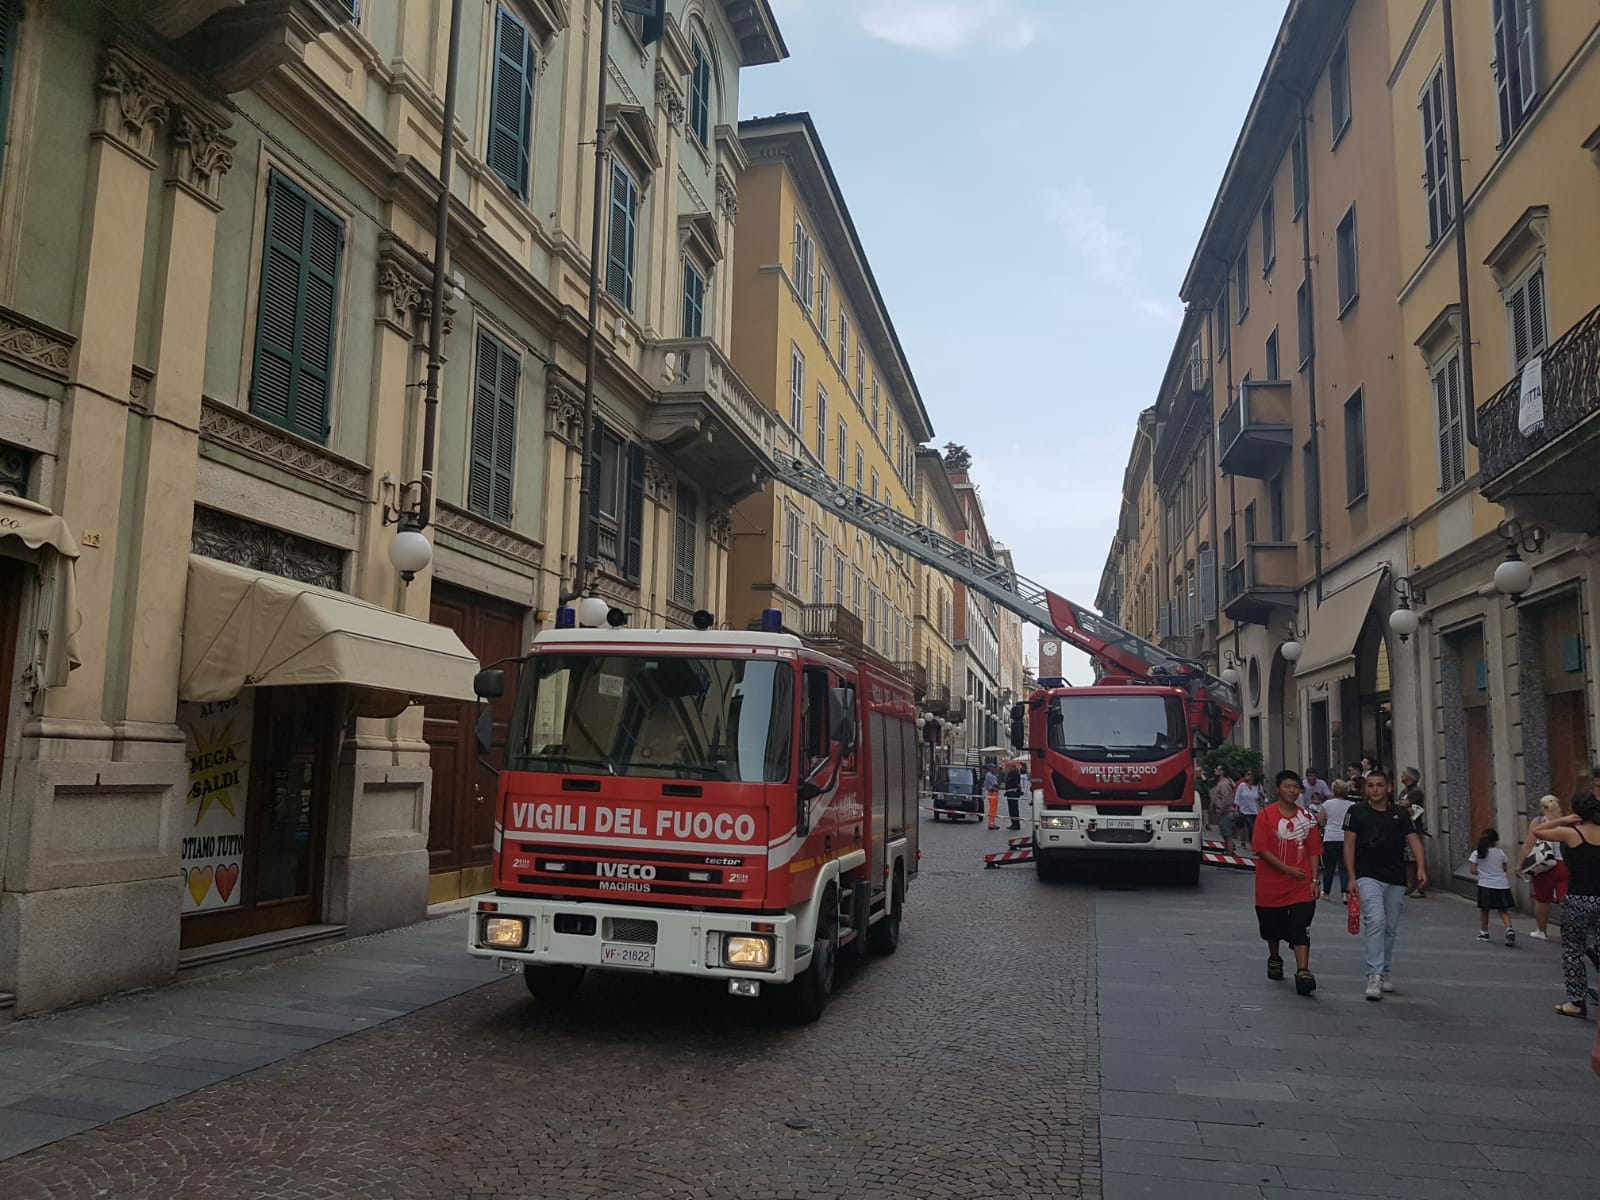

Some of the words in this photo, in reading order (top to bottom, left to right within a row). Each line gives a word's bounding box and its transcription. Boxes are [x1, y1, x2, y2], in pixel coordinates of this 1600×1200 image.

[190, 749, 237, 773] MEGA
[1080, 766, 1105, 775] VIGILI
[1107, 766, 1124, 775] DEL
[1127, 766, 1157, 775] FUOCO
[192, 770, 239, 798] SALDI
[512, 802, 586, 832] VIGILI
[595, 807, 648, 835] DEL
[656, 811, 755, 841] FUOCO
[217, 833, 244, 857] TUTTO
[596, 861, 657, 881] IVECO
[705, 857, 741, 866] tector
[599, 881, 651, 893] MAGIRUS
[622, 949, 650, 962] 21822
